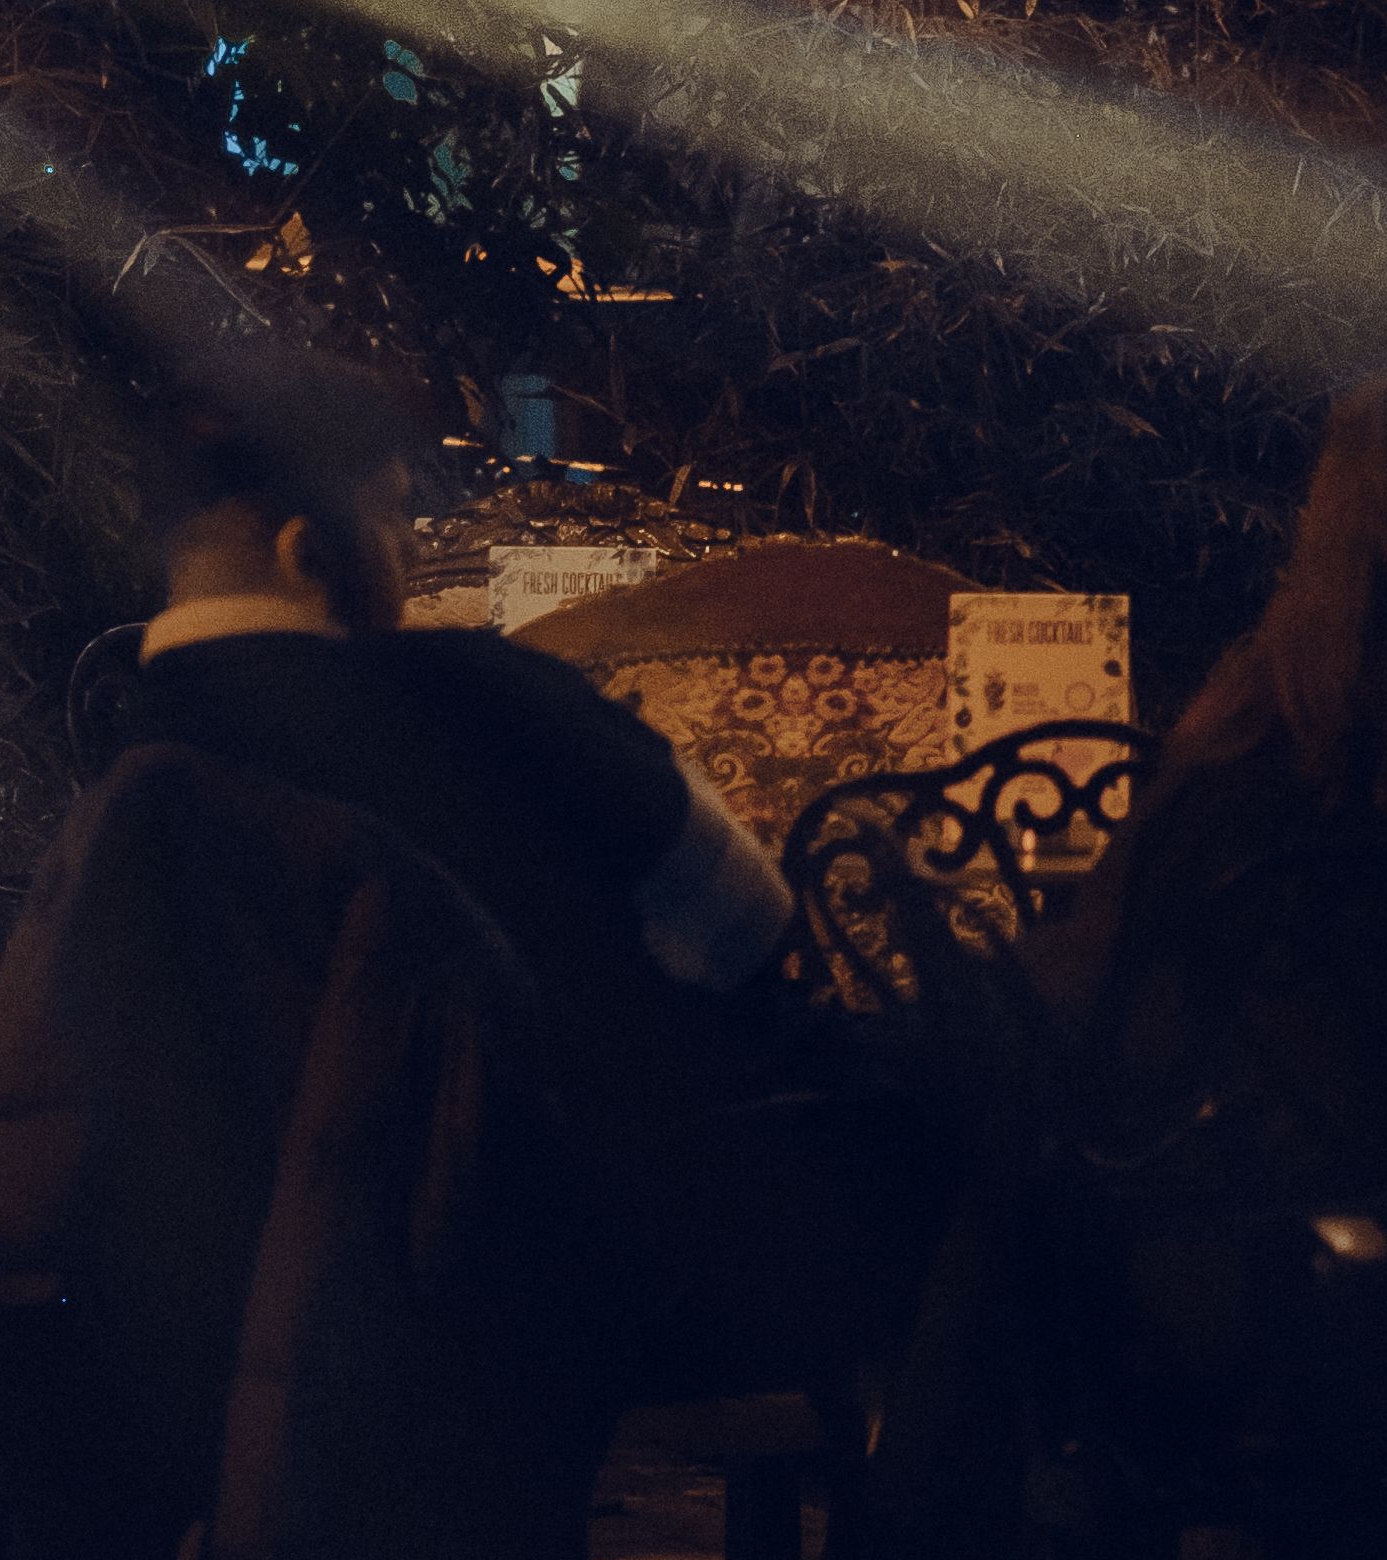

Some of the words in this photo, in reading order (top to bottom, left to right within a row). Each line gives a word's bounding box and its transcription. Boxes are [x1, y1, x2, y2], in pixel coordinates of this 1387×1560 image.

[522, 571, 558, 595] FRESH
[987, 620, 1025, 644] FRESH
[1028, 620, 1094, 645] COCKTAILS
